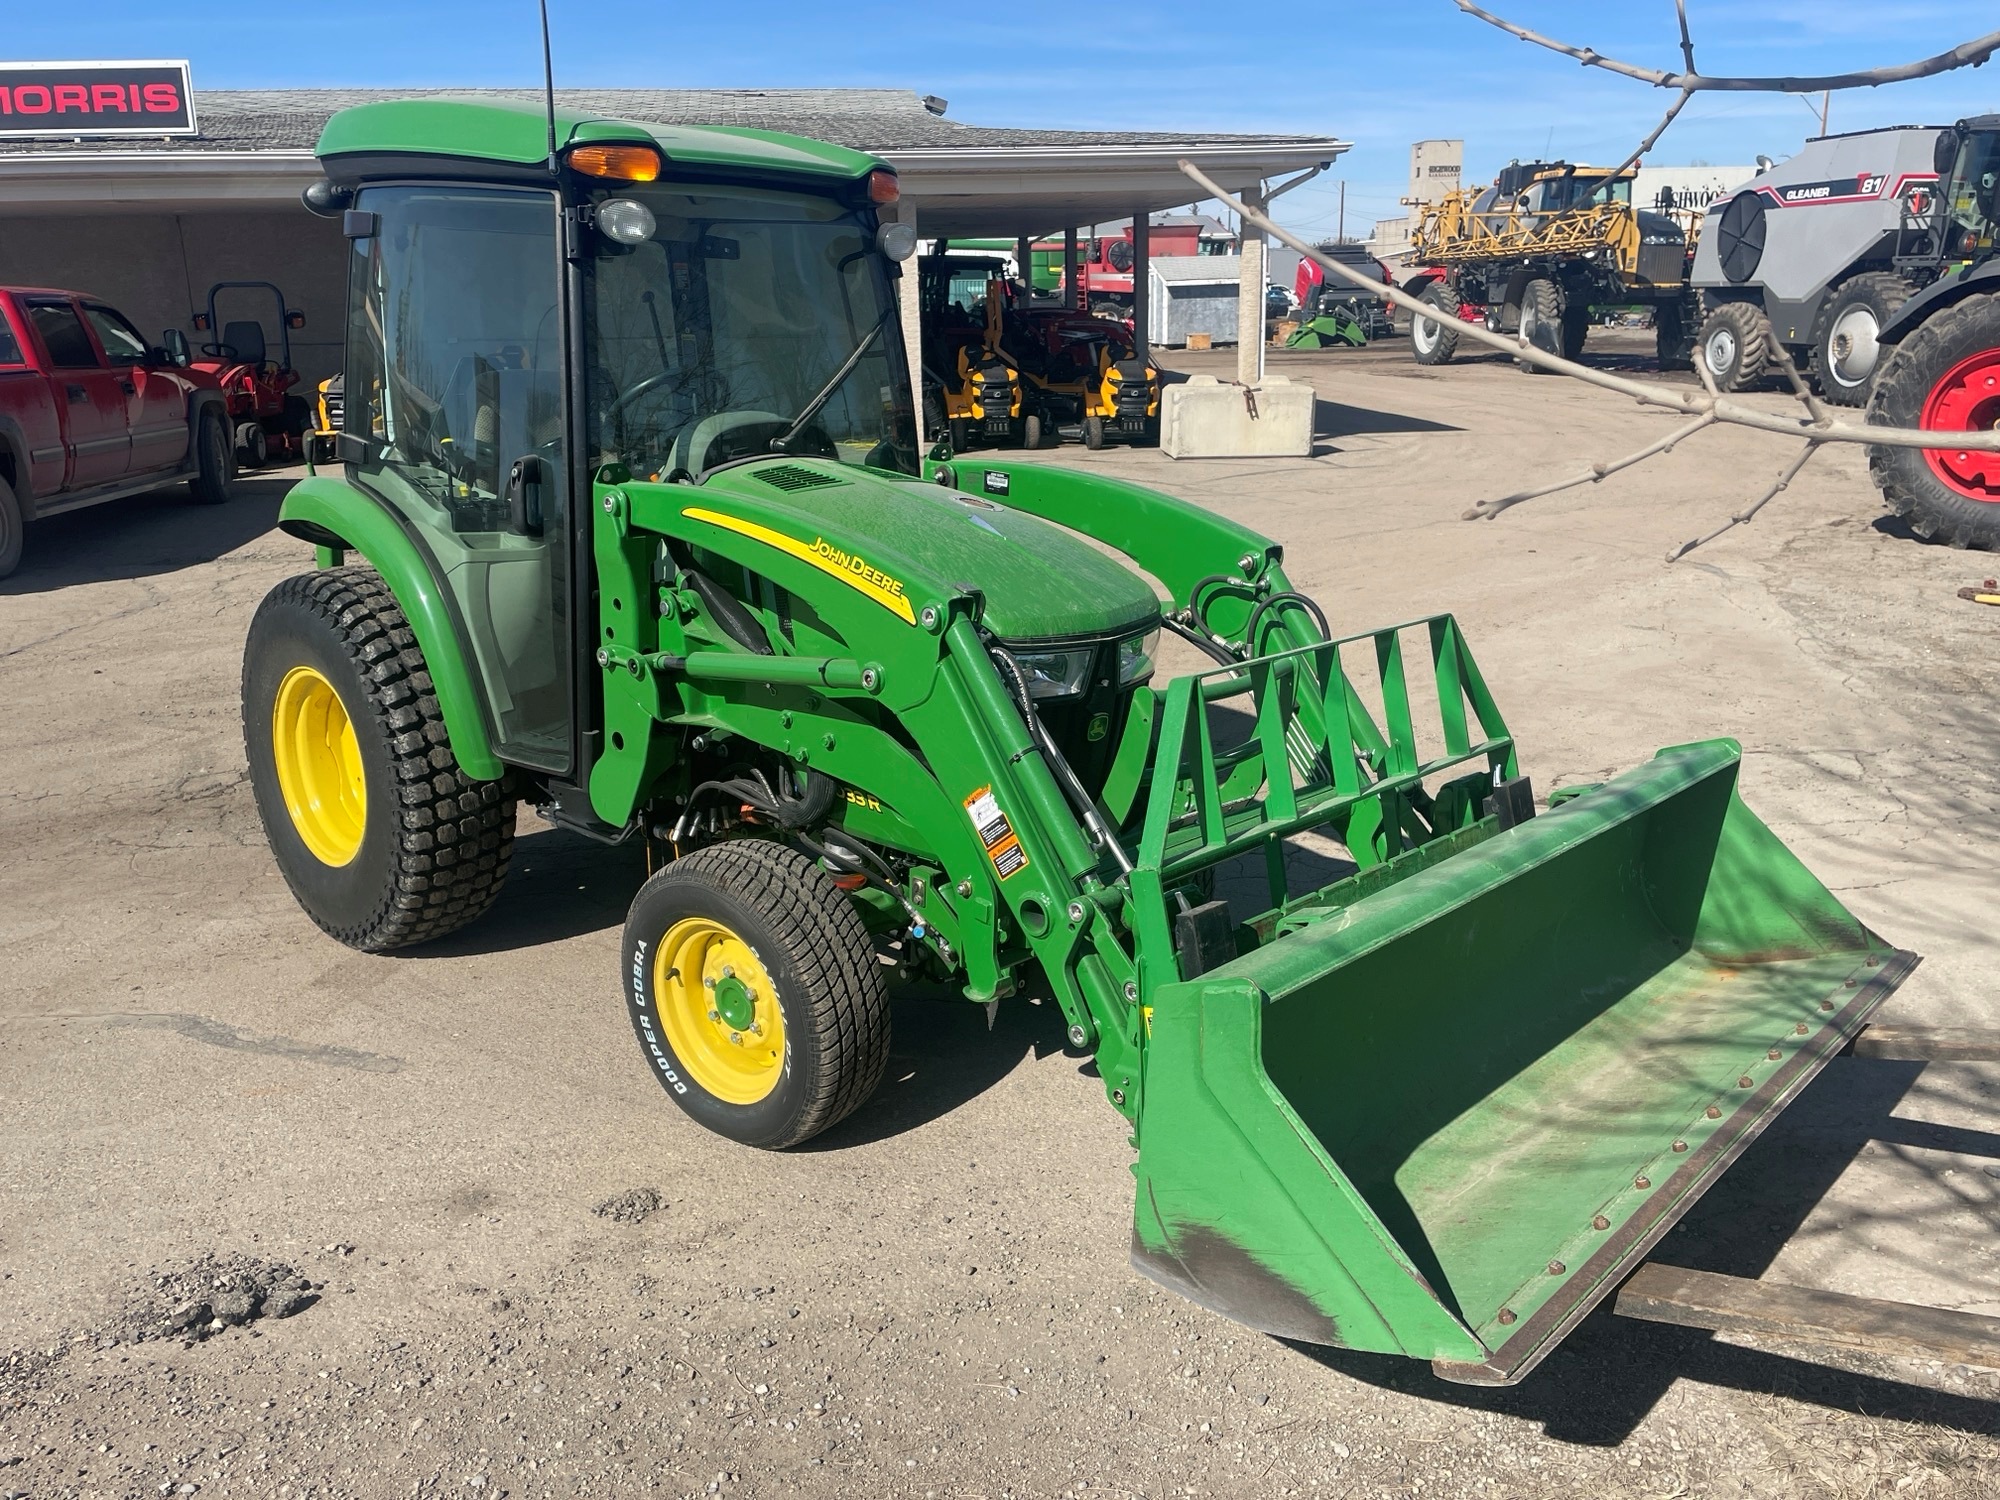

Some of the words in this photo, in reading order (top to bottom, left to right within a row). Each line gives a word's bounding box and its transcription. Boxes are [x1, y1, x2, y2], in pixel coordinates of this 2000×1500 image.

[0, 84, 180, 115] ORRIS
[1786, 186, 1831, 201] GLEANER
[808, 536, 851, 571] JOHN
[848, 555, 905, 598] DEERE
[633, 939, 648, 1007] COBRA
[639, 1014, 688, 1095] COOPER
